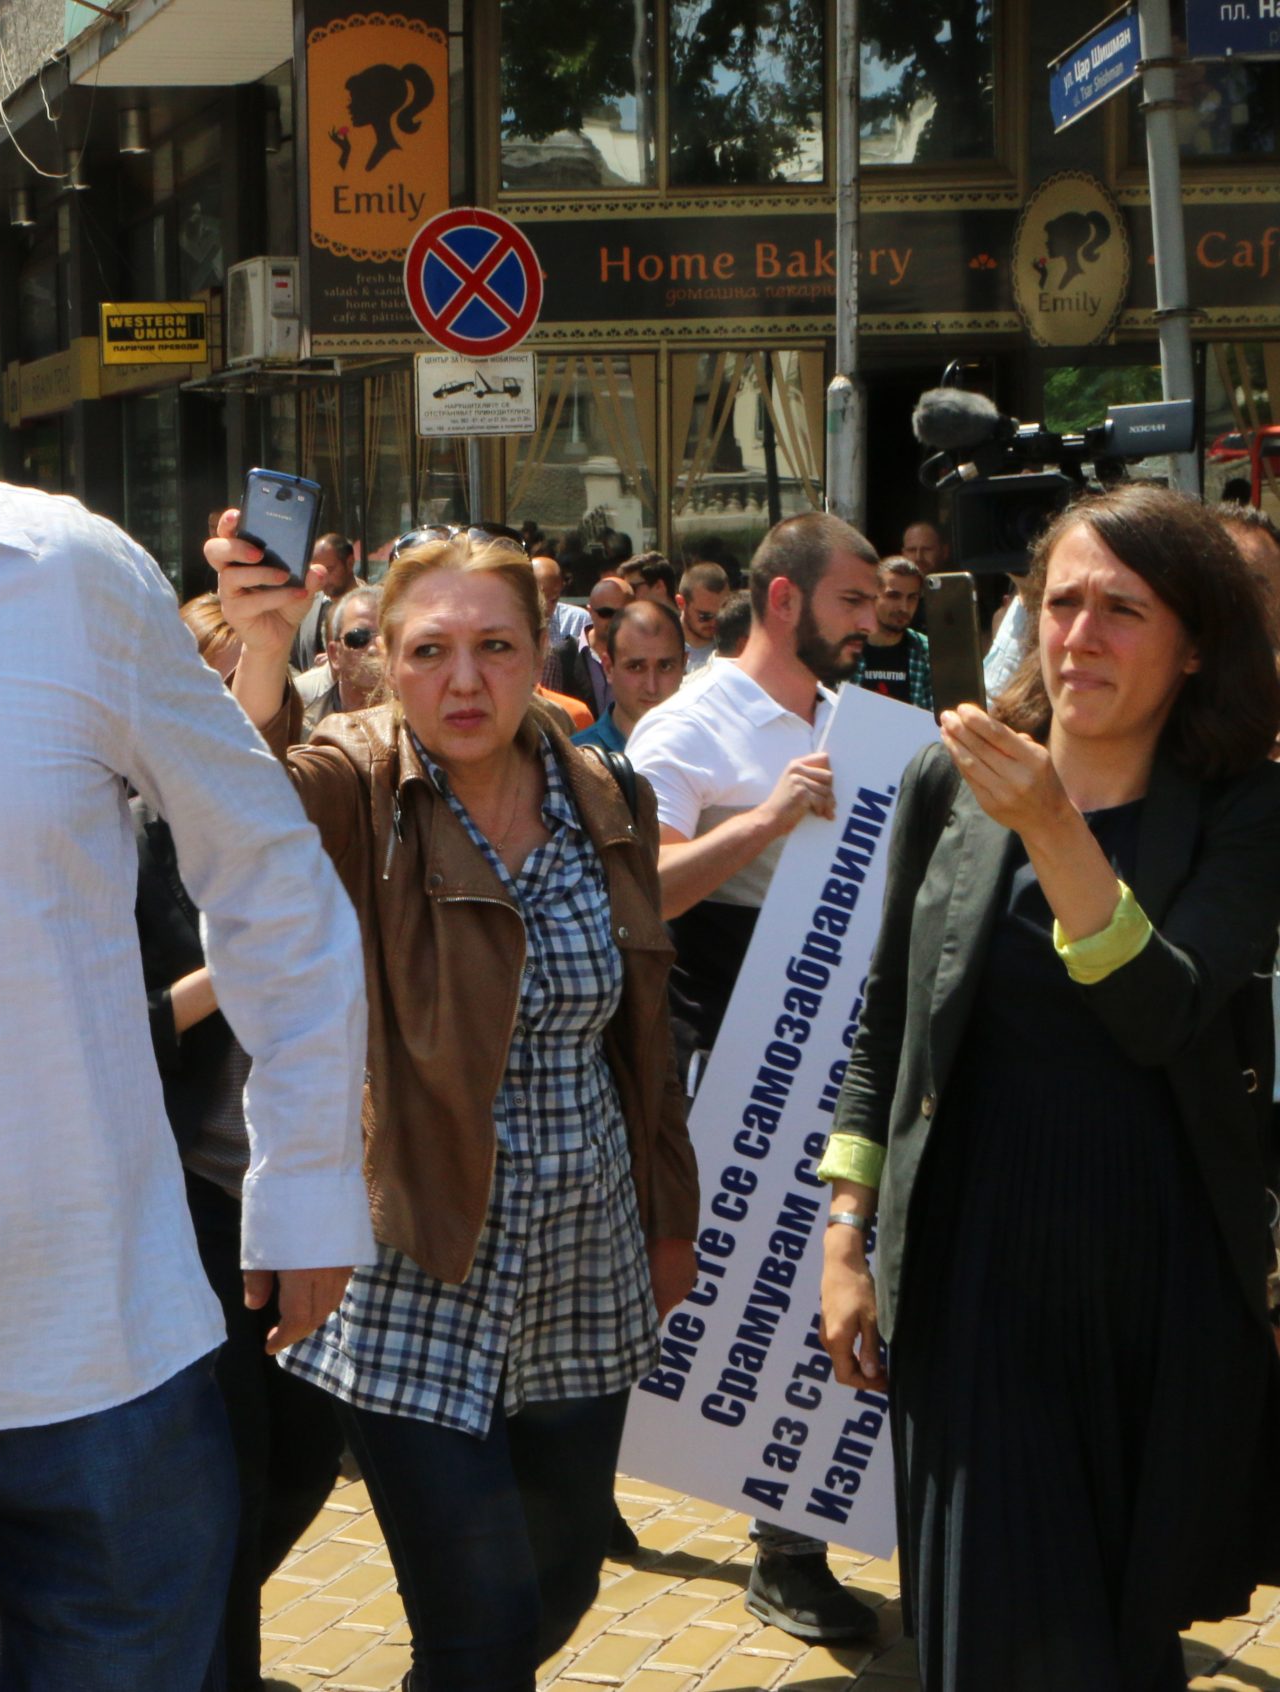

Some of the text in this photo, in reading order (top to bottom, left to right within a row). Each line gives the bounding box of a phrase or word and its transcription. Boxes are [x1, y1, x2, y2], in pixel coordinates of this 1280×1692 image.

[1221, 3, 1250, 21] пл.
[1074, 57, 1091, 83] Цар
[1090, 27, 1131, 69] Шишман
[333, 183, 426, 222] Emily
[600, 239, 913, 286] Home Bakry
[1196, 226, 1280, 278] Caf
[109, 316, 186, 328] WESTERN
[1038, 292, 1101, 317] Emily
[134, 327, 187, 339] UNION
[158, 343, 199, 351] ПРЕВОДИ
[733, 785, 897, 1161] самозабравили.
[711, 1166, 758, 1222] се
[700, 1190, 821, 1428] Срамувам
[638, 1311, 706, 1402] Вие
[762, 1415, 809, 1475] аз
[741, 1475, 790, 1512] А
